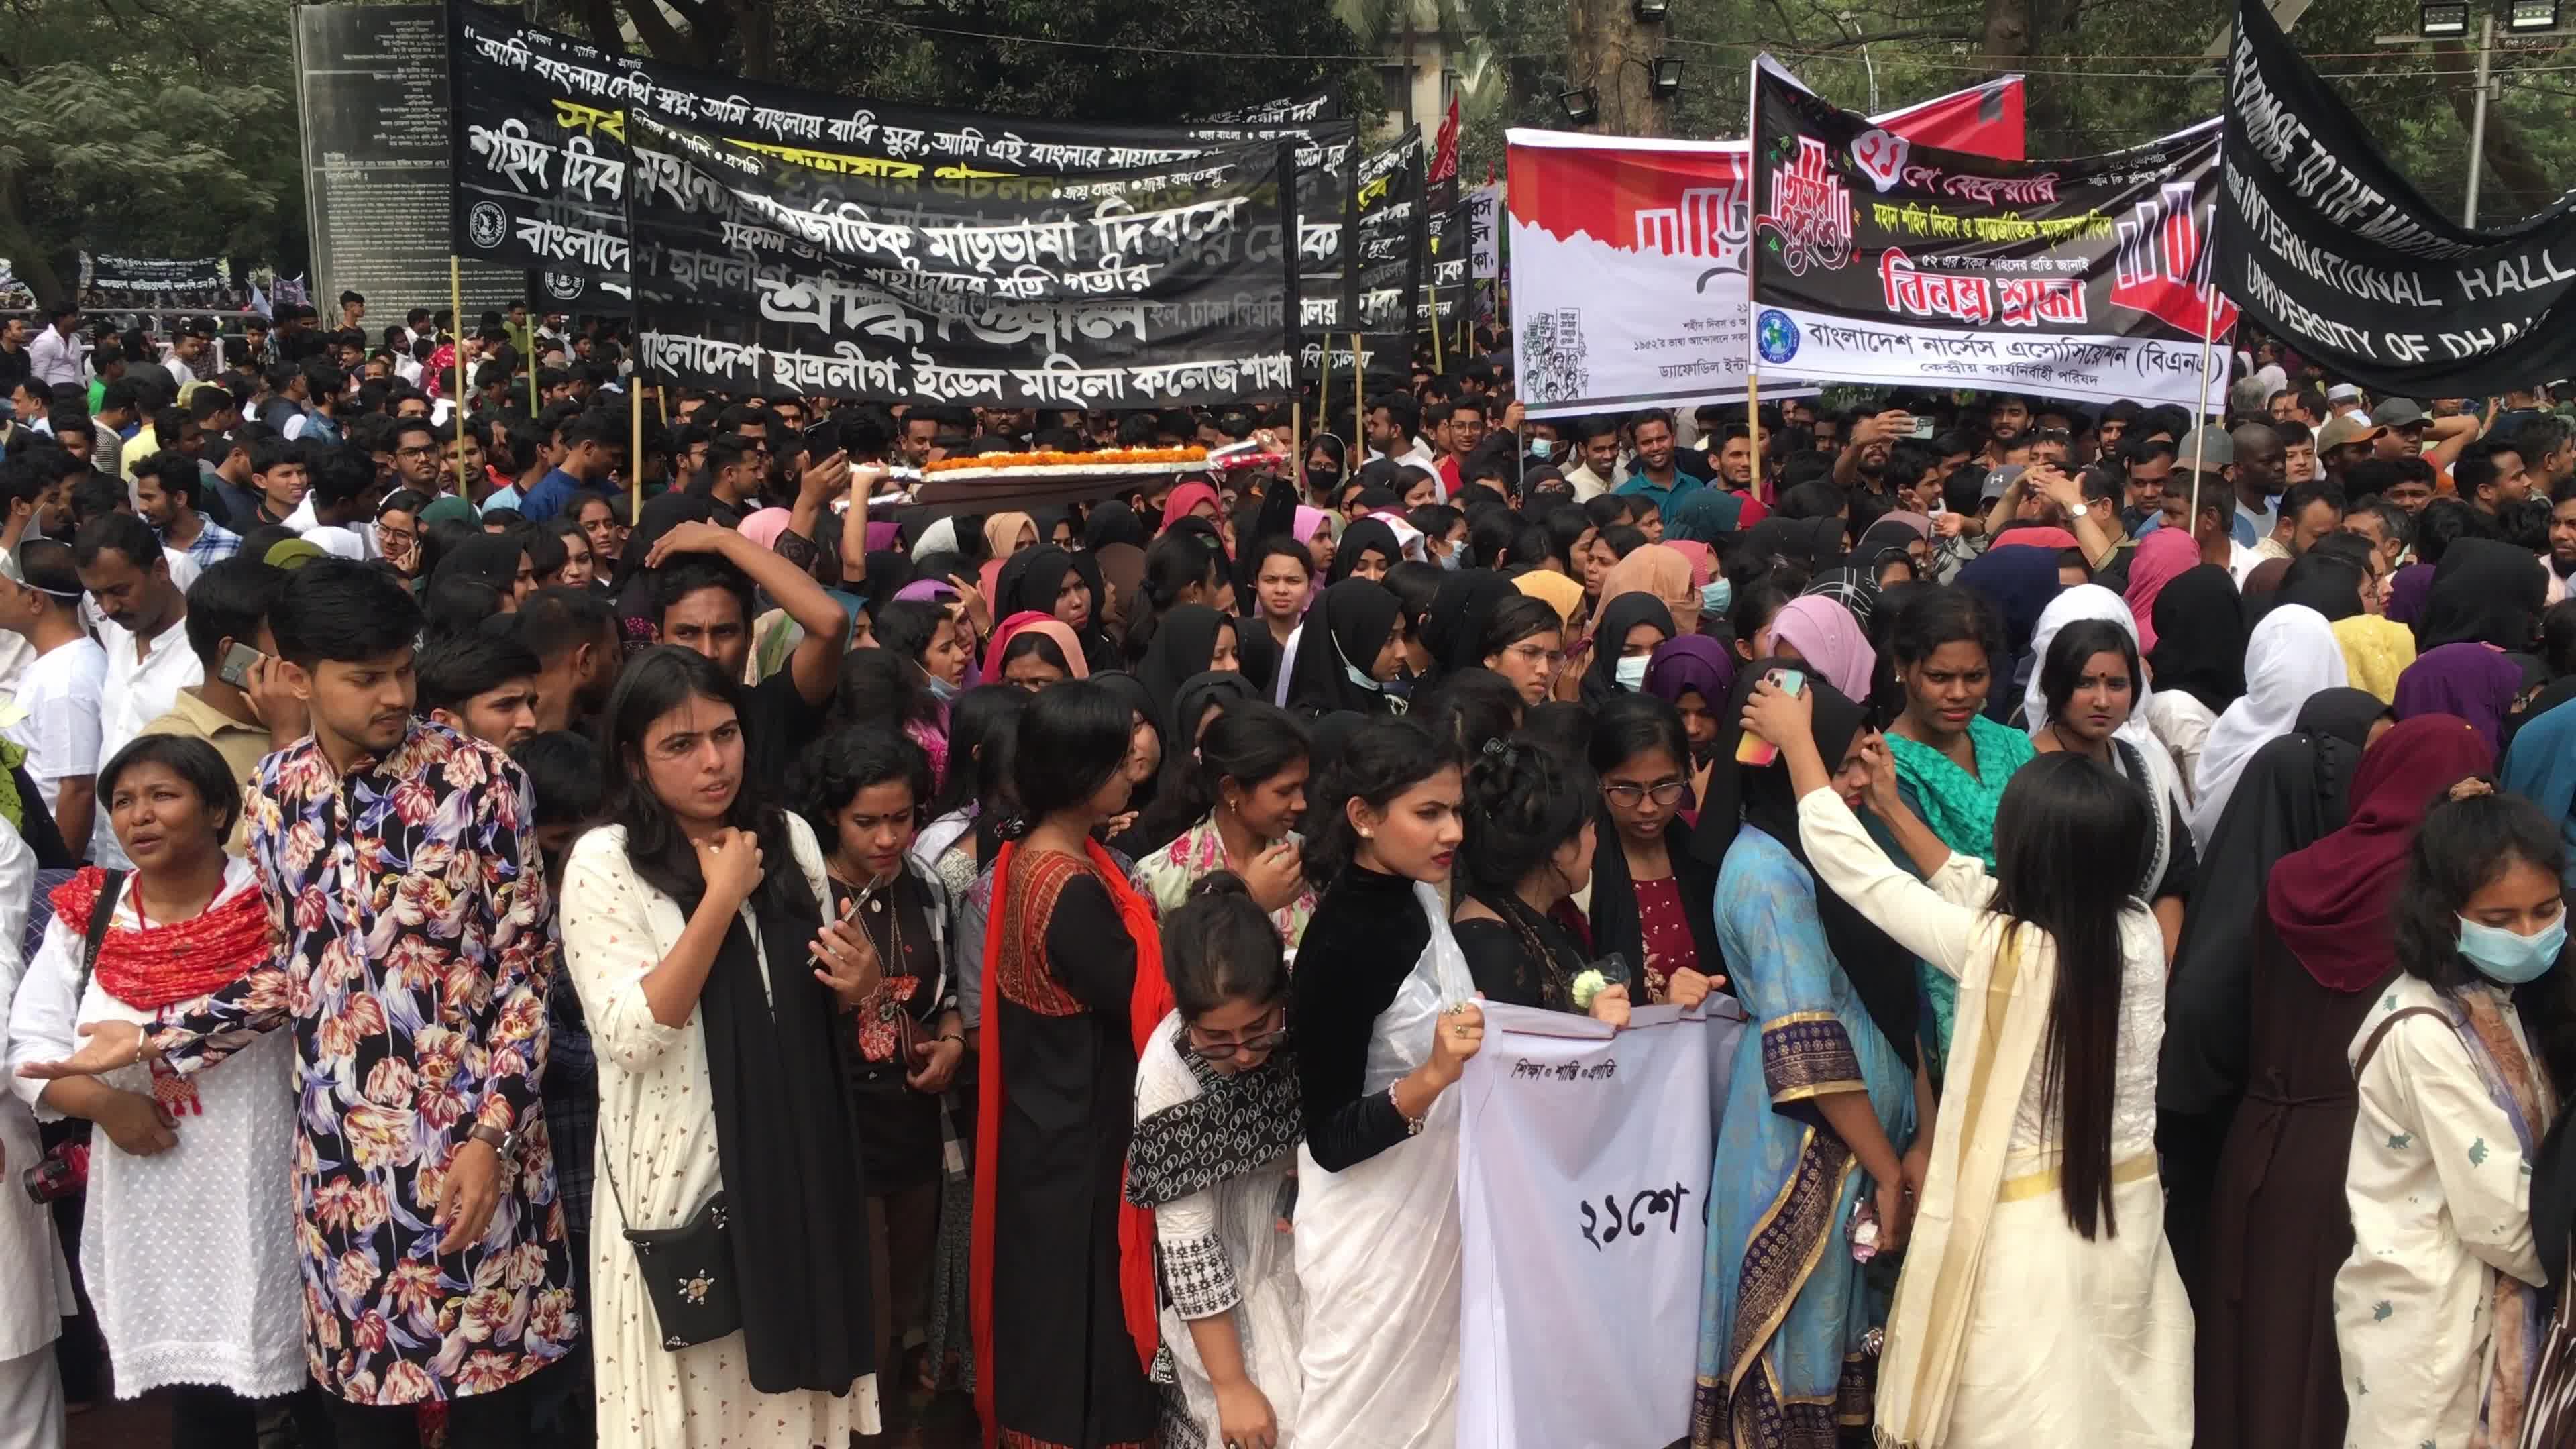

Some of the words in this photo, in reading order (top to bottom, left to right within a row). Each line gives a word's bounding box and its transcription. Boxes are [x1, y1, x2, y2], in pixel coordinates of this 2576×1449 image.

[469, 118, 558, 193] শহিদ
[561, 136, 625, 202] দিব
[752, 107, 825, 142] বাংলায়
[932, 127, 985, 158] আমি
[986, 131, 1030, 168] এই
[1028, 143, 1106, 172] বাংলার
[516, 216, 631, 272] বাংলাদে
[1872, 203, 1899, 233] মহান
[1929, 205, 1958, 236] দিবস
[2240, 176, 2443, 307] INTERNATIONAL
[2456, 248, 2576, 301] HALL
[1878, 246, 1992, 326] বিনম্র
[1995, 277, 2088, 327] শ্রদ্ধা
[2247, 251, 2379, 360] UNIVERSITY
[2384, 333, 2431, 362] OF
[2438, 308, 2551, 359] DHA
[639, 327, 766, 380] বাংলাদেশ
[769, 340, 908, 396] ছাত্রলীগ,
[910, 345, 1008, 403] ইডেন
[1009, 352, 1127, 409] মহিলা
[1130, 358, 1240, 400] কলেজ
[1239, 349, 1293, 391] শাখা
[1658, 359, 1719, 380] ড্যাফোডিল
[1804, 322, 1914, 355] বাংলাদেশ
[1918, 333, 1998, 359] নার্সেস
[2006, 337, 2131, 370] এসোসিয়েশন
[1920, 360, 1979, 376] কেন্দ্রীয়
[1986, 360, 2053, 382] কার্যনির্বাহী
[2057, 367, 2099, 386] পরিষদ
[1511, 1057, 1546, 1081] শিক্ষা
[1554, 1059, 1581, 1083] শান্তি
[1587, 1058, 1618, 1082] প্রগতি
[1579, 1181, 1690, 1252] ২১শে
